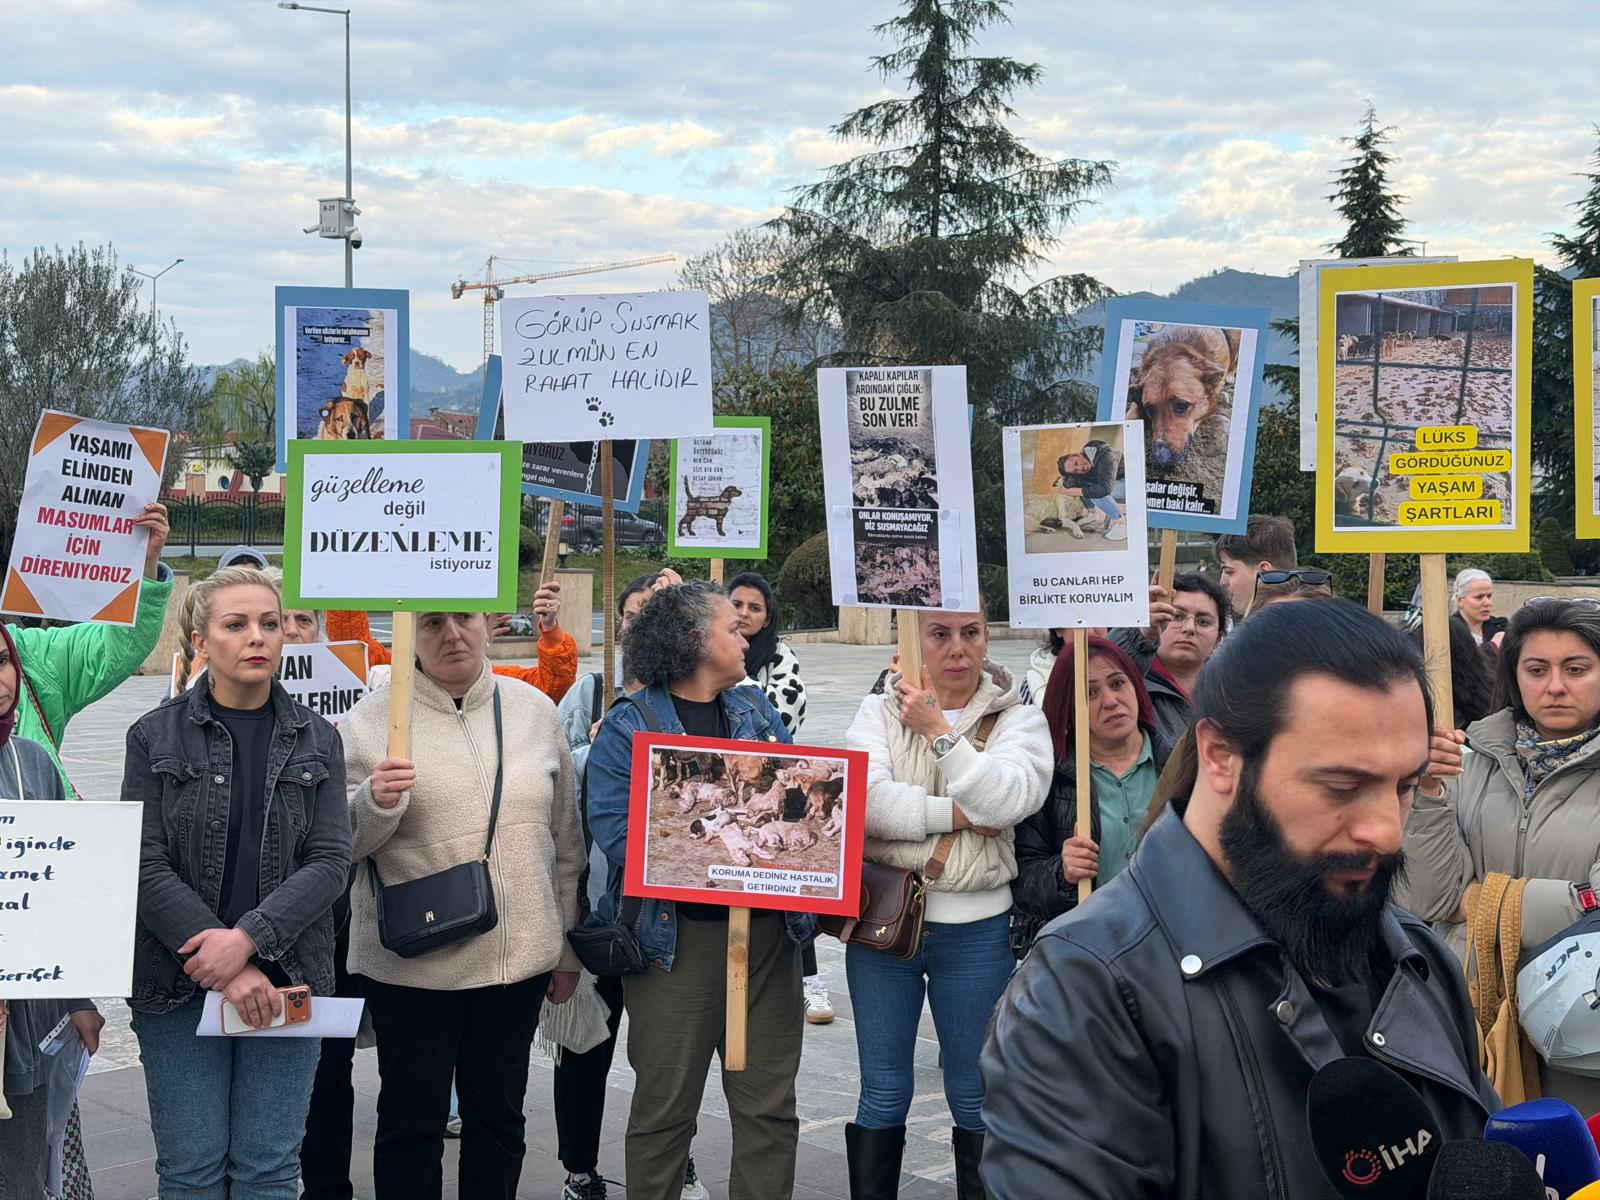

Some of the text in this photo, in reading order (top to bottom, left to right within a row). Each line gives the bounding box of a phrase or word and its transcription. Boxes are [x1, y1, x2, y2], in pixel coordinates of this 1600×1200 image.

[515, 306, 602, 340] GÖRÜP
[517, 339, 658, 366] ZULMÜN EN
[525, 372, 593, 393] RAHAT
[859, 370, 919, 381] KAPALI KAPILAR
[855, 382, 895, 394] ARDINDAKİ
[860, 396, 920, 411] BU ZULME
[862, 412, 918, 427] SON VER!
[1422, 429, 1466, 444] LÜKS
[69, 432, 133, 461] YAŞAMI
[1395, 453, 1505, 469] GÖRDÜĞÜNÜZ
[61, 458, 133, 486] ELİNDEN
[522, 461, 585, 479] ze zarar verenlere
[310, 466, 425, 502] güzelleme
[521, 472, 555, 485] ngel olun
[1146, 481, 1198, 499] salar değişir,
[1417, 480, 1475, 496] YAŞAM
[61, 485, 125, 509] ALINAN
[1146, 497, 1166, 509] met
[1165, 497, 1184, 511] baki
[383, 500, 426, 519] değil
[858, 511, 934, 524] ONLAR KONUŞAMIYOR,
[1405, 506, 1493, 522] ŞARTLARI
[37, 507, 135, 535] MASUMLAR
[864, 520, 928, 533] BİZ SUSMAYACAĞIZ
[65, 533, 101, 556] İÇİN
[310, 528, 493, 553] DÜZENLEME
[430, 557, 492, 573] istiyoruz
[1033, 575, 1124, 587] BU CANLARI HEP
[1019, 592, 1133, 605] BİRLİKTE KORUYALIM
[711, 867, 751, 878] KORUMA
[752, 870, 788, 880] DEDİNİZ
[747, 882, 797, 894] GETİRDİNİZ
[1379, 1128, 1432, 1171] İHA
